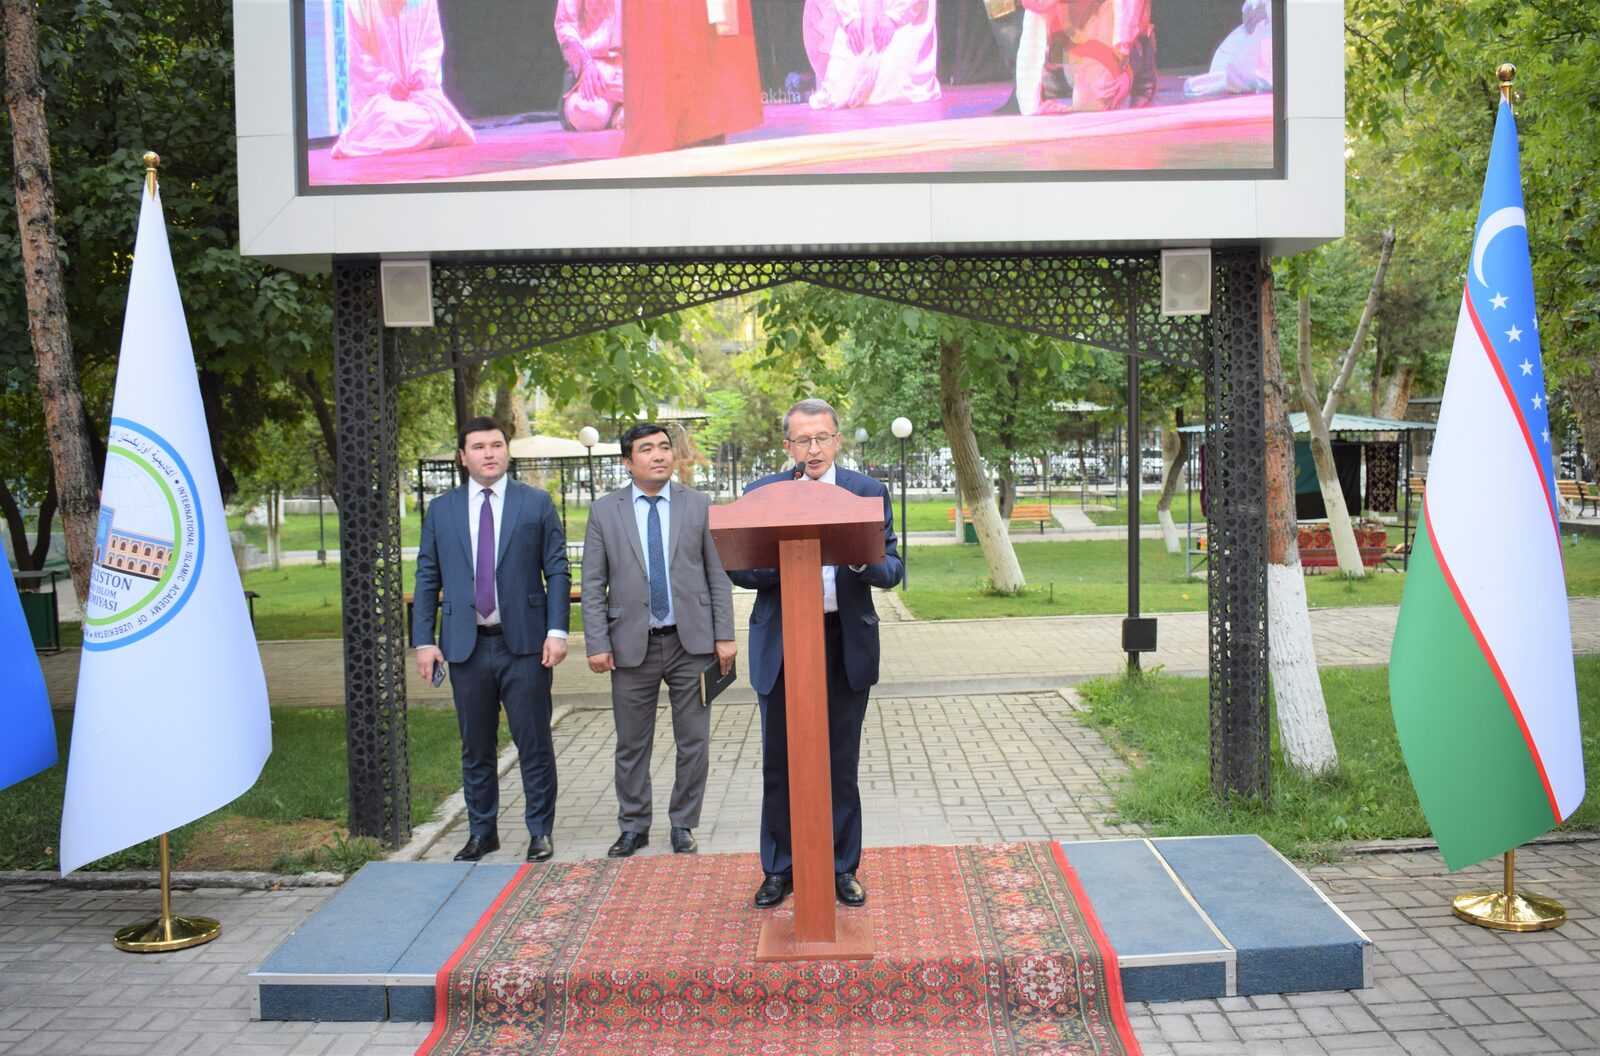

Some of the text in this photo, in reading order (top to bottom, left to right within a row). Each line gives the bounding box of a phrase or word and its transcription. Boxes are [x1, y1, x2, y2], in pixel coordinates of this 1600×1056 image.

[94, 486, 194, 638] INTERNATIONAL ISLAMIC ACADEMY OF UZBEKISTAN
[96, 586, 117, 599] ISLOM
